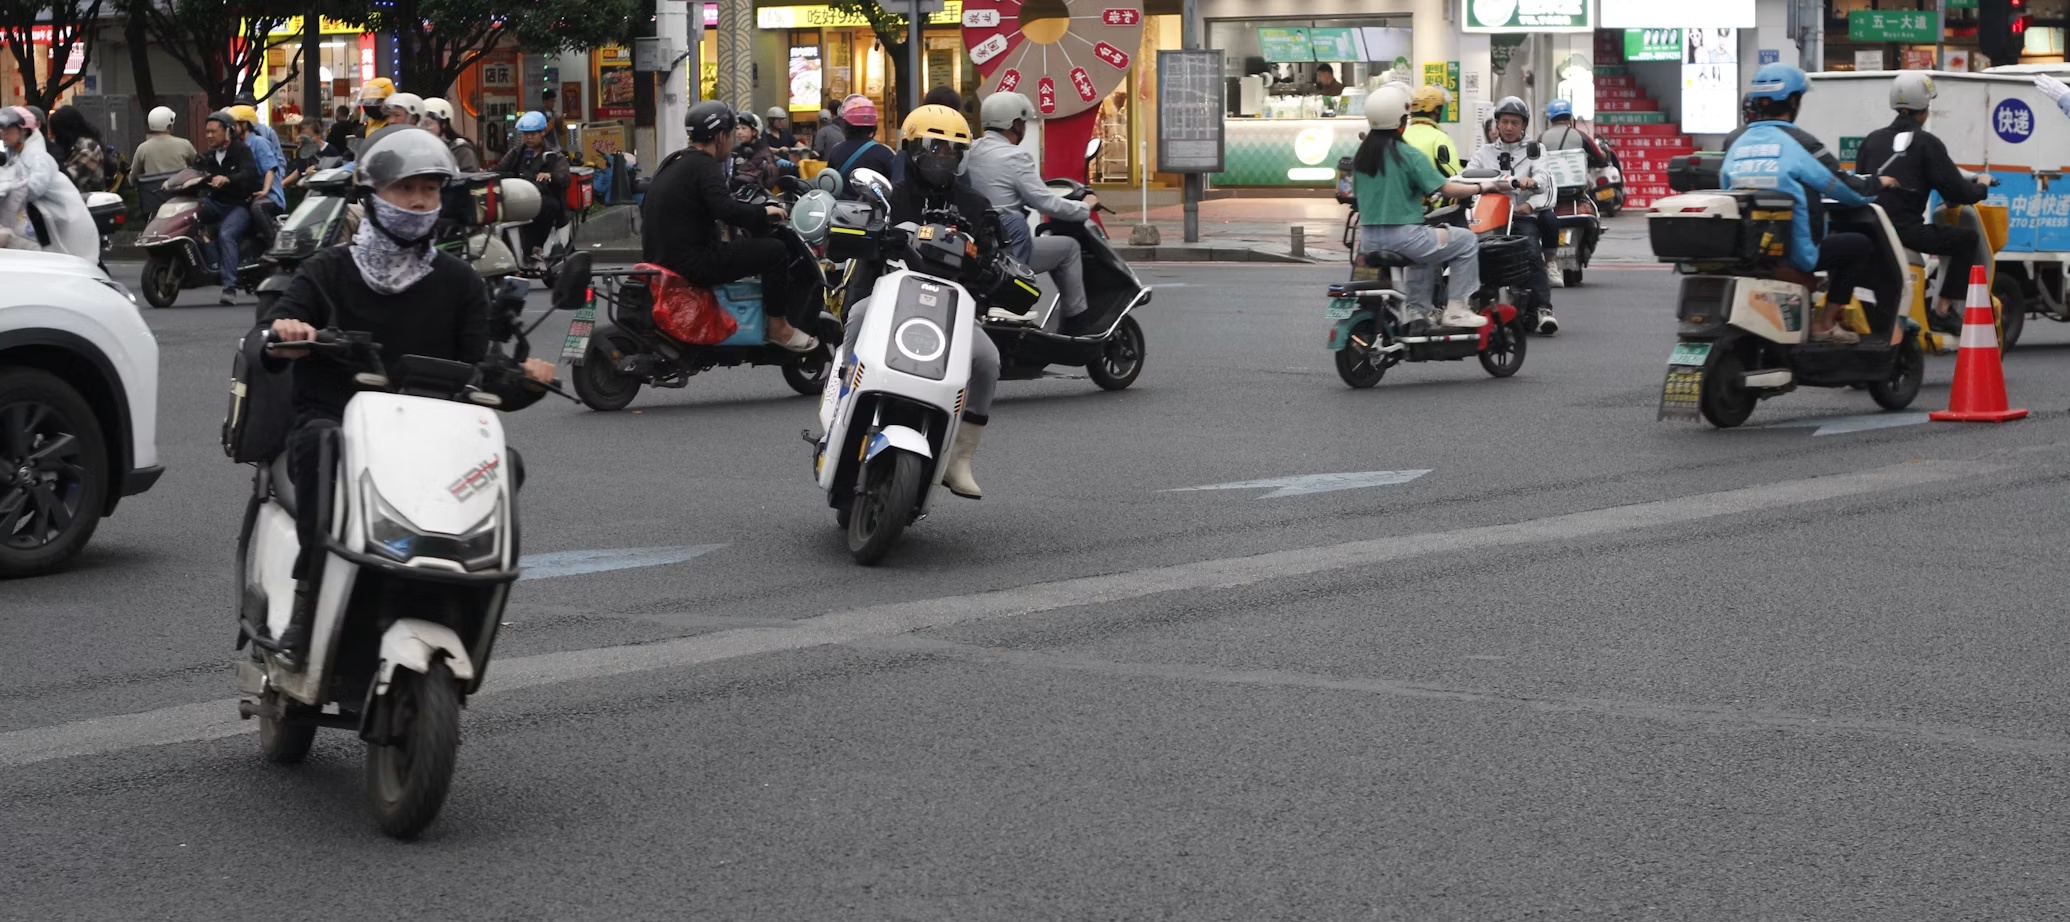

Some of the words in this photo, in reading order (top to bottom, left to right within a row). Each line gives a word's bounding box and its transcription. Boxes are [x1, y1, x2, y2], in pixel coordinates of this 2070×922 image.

[808, 11, 869, 24] 吃好9块
[1872, 15, 1927, 29] 五一大道
[1040, 83, 1054, 107] 公正
[1074, 71, 1092, 96] 平等
[1998, 107, 2030, 135] 快递
[2011, 194, 2070, 217] 中通快递
[2010, 218, 2028, 228] ZTO
[2029, 217, 2069, 228] EXPRESS
